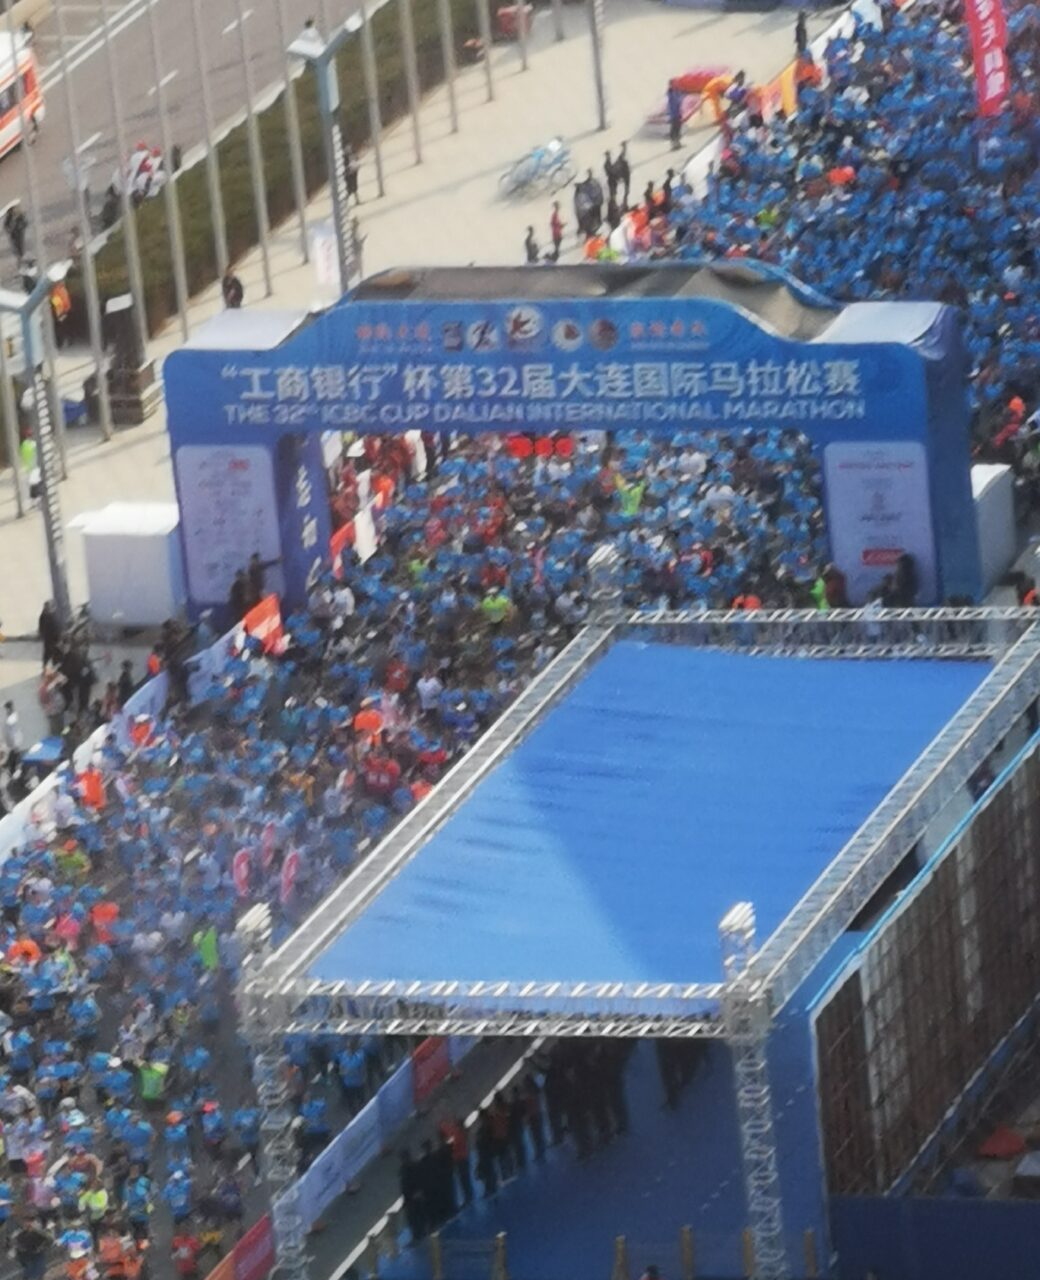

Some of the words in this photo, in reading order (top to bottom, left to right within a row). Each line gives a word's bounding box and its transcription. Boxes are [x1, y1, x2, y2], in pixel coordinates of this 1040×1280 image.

[224, 402, 271, 425] THE
[321, 402, 378, 425] ICBC
[380, 402, 431, 424] CUP
[434, 402, 525, 423] DALIAN
[526, 401, 717, 423] INTERNATIONAL
[724, 400, 865, 421] MARATHON
